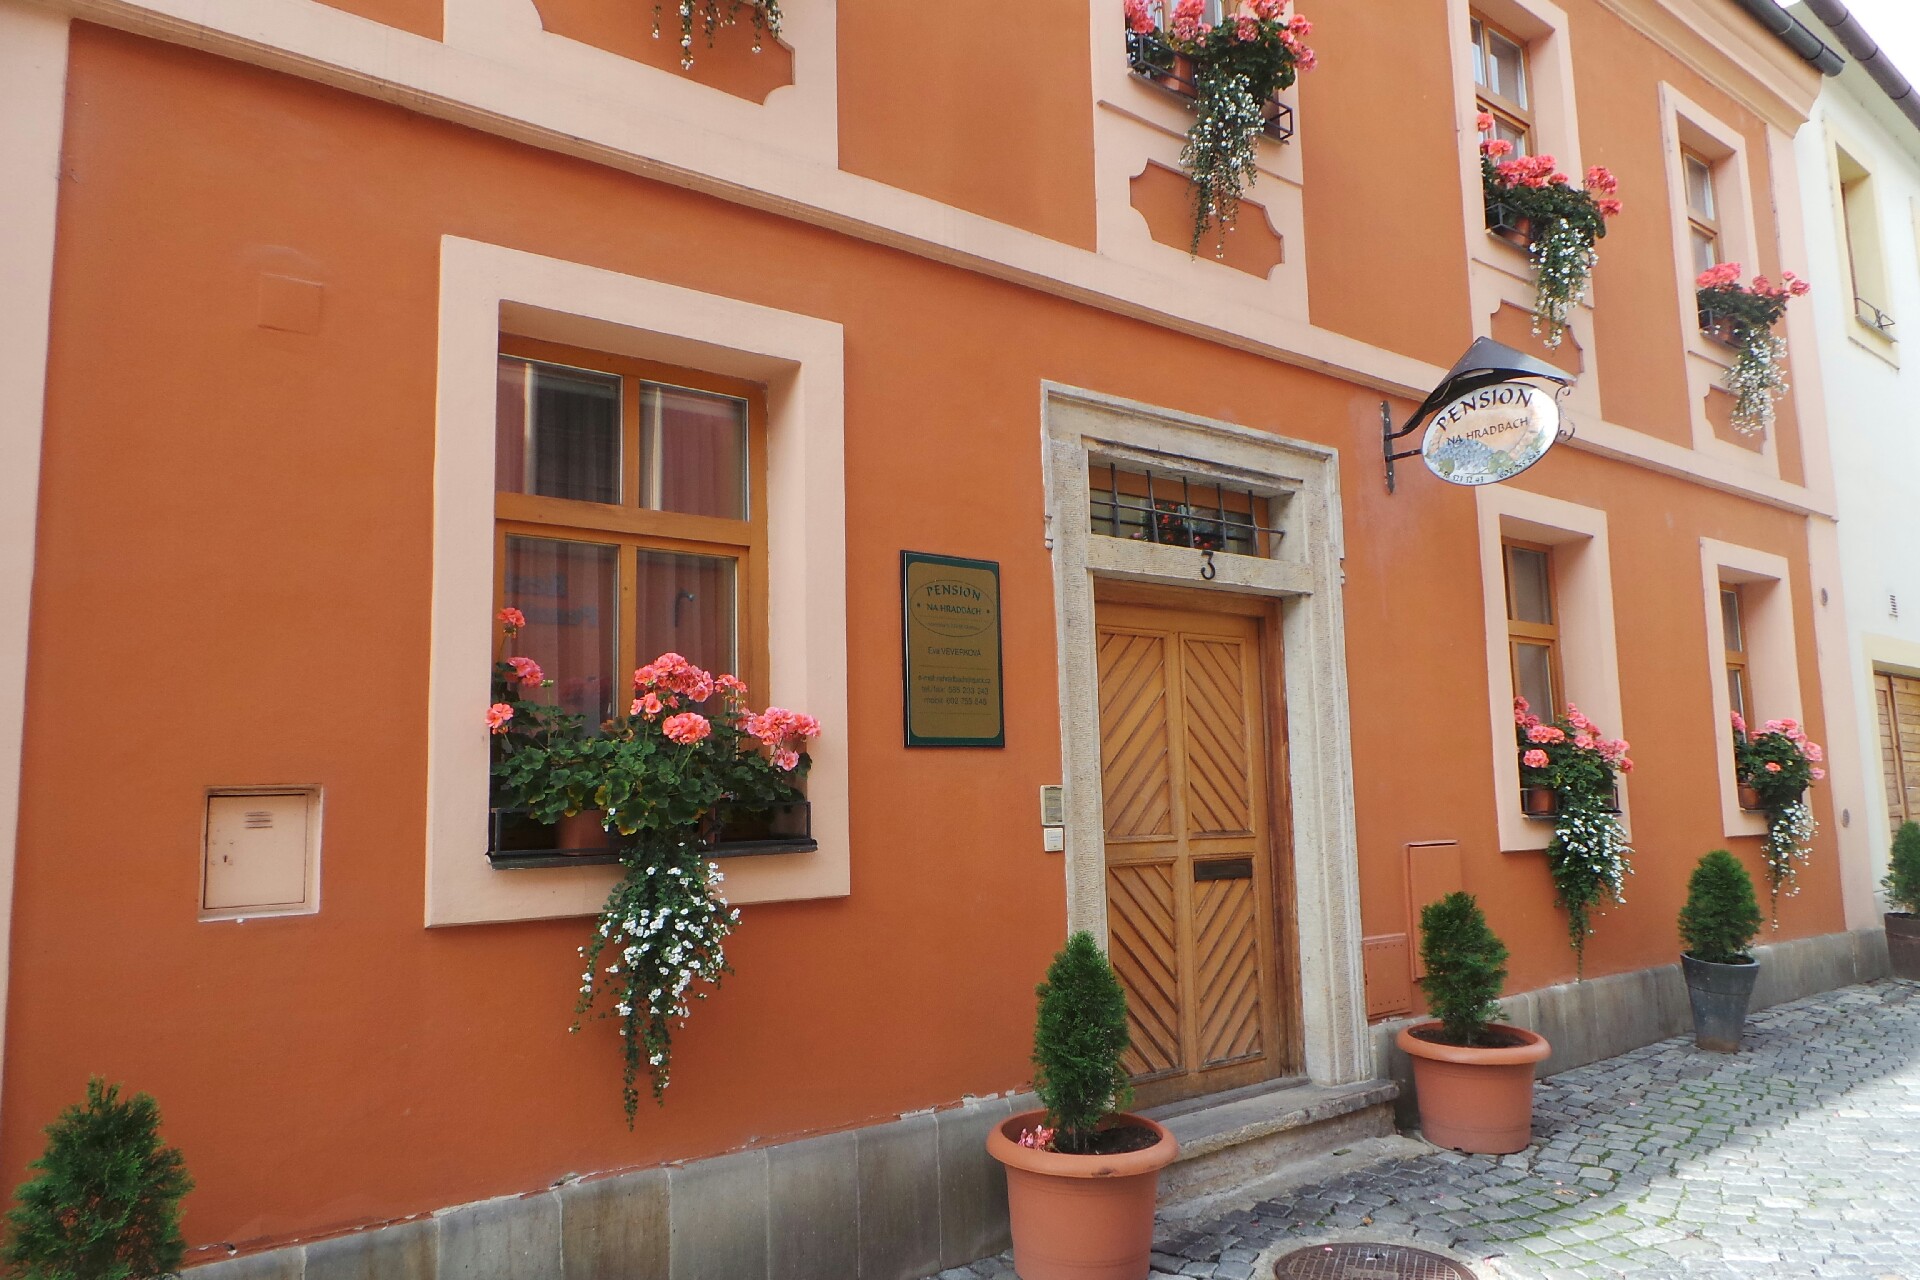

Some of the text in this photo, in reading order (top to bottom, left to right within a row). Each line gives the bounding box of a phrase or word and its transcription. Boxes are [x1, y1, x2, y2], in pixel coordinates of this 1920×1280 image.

[1436, 388, 1533, 431] PENSION
[1447, 417, 1528, 445] NA HRADBACH
[1200, 549, 1216, 580] 3
[927, 584, 981, 601] PENSION
[926, 603, 939, 611] NA
